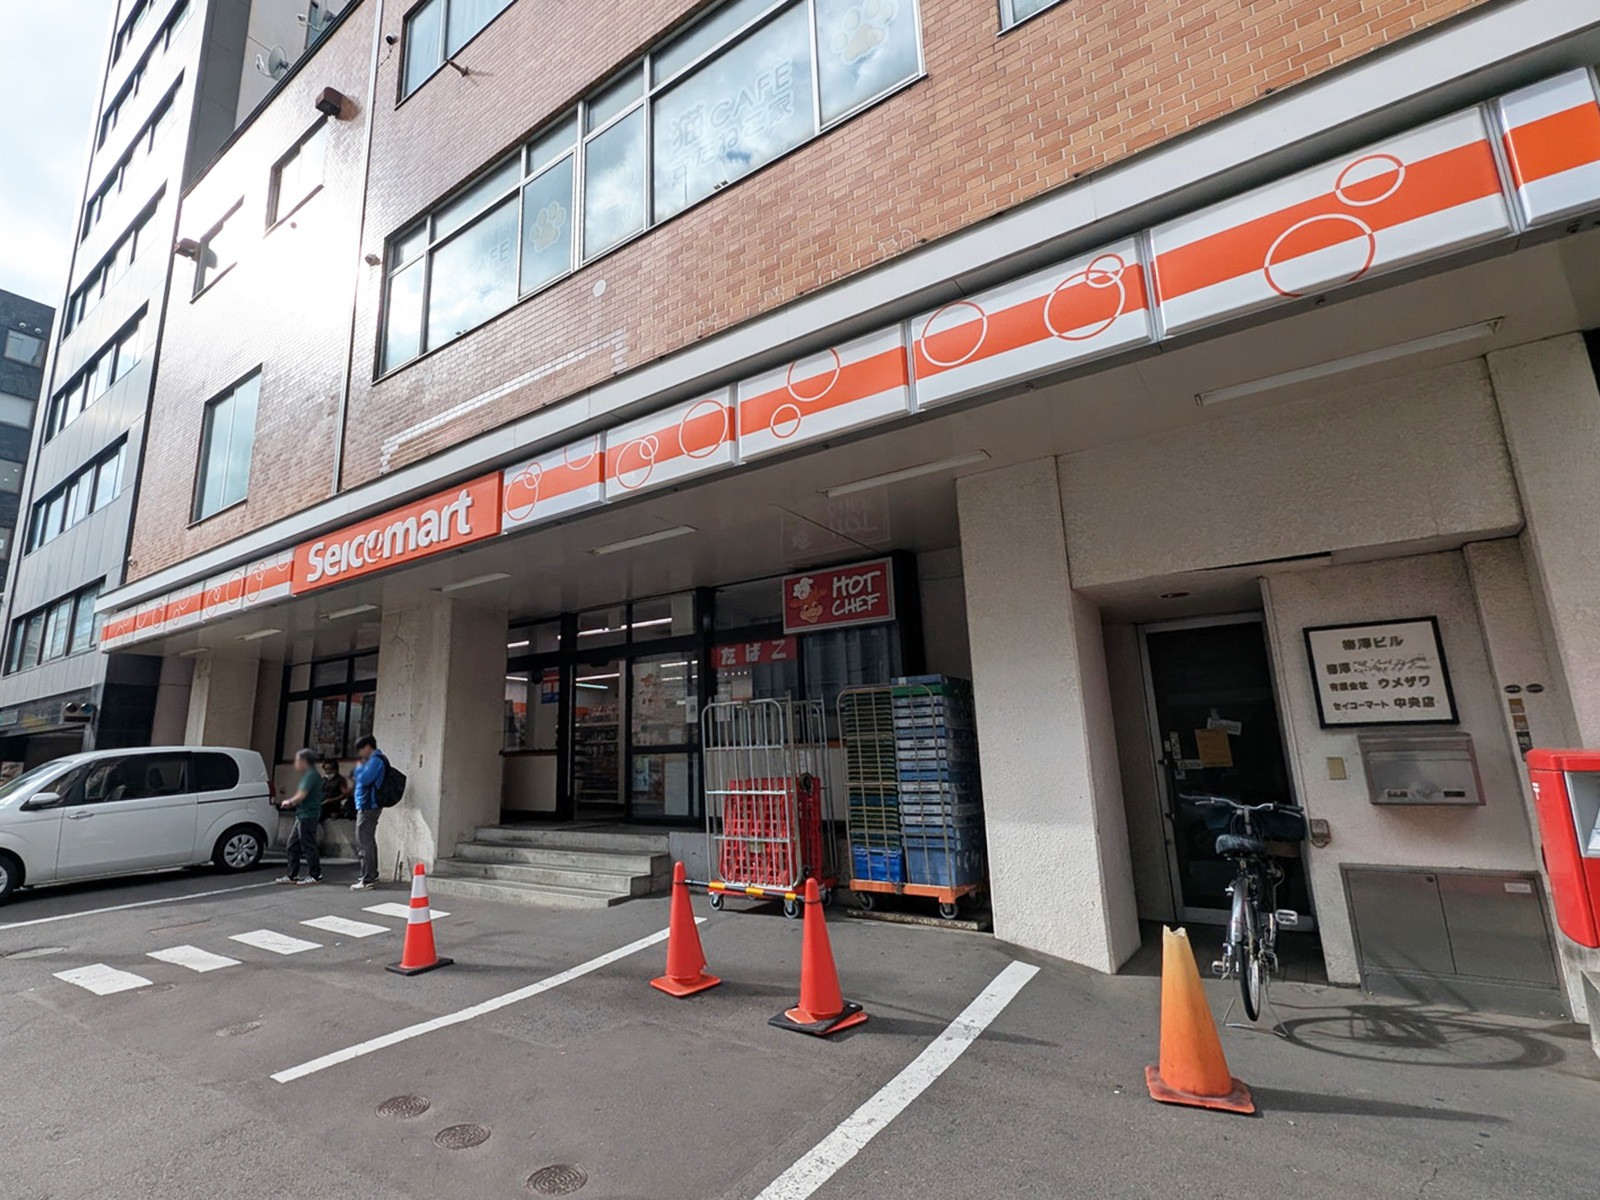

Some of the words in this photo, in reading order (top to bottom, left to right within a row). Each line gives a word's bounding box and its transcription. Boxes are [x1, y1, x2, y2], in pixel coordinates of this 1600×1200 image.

[306, 488, 473, 583] Seicomart
[831, 570, 882, 598] HOT
[831, 592, 881, 617] CHEF
[720, 639, 787, 666] たばこ
[1329, 681, 1369, 692] 有限会社
[1378, 675, 1430, 689] ウメザワ
[1333, 700, 1389, 711] セイコーマート
[1393, 695, 1436, 709] 中央店
